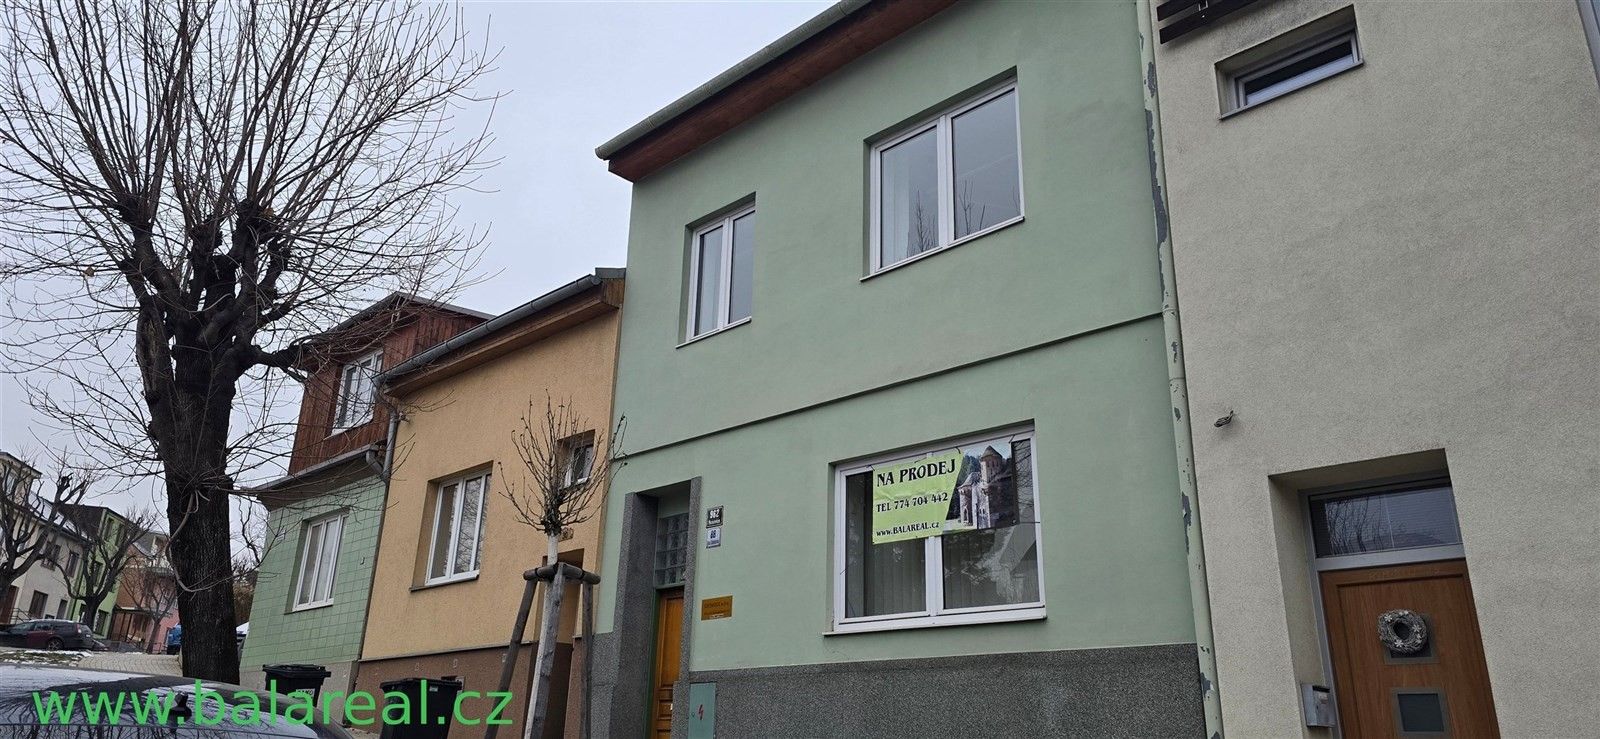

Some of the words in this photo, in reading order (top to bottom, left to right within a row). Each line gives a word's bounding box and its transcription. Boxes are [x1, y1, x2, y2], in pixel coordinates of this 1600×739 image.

[877, 472, 894, 487] NA
[899, 459, 956, 483] PRODEJ
[876, 502, 891, 513] TEL
[894, 499, 910, 510] 774
[913, 496, 928, 507] 704
[931, 492, 948, 503] 442
[876, 521, 940, 537] www.BALAREAL.cz
